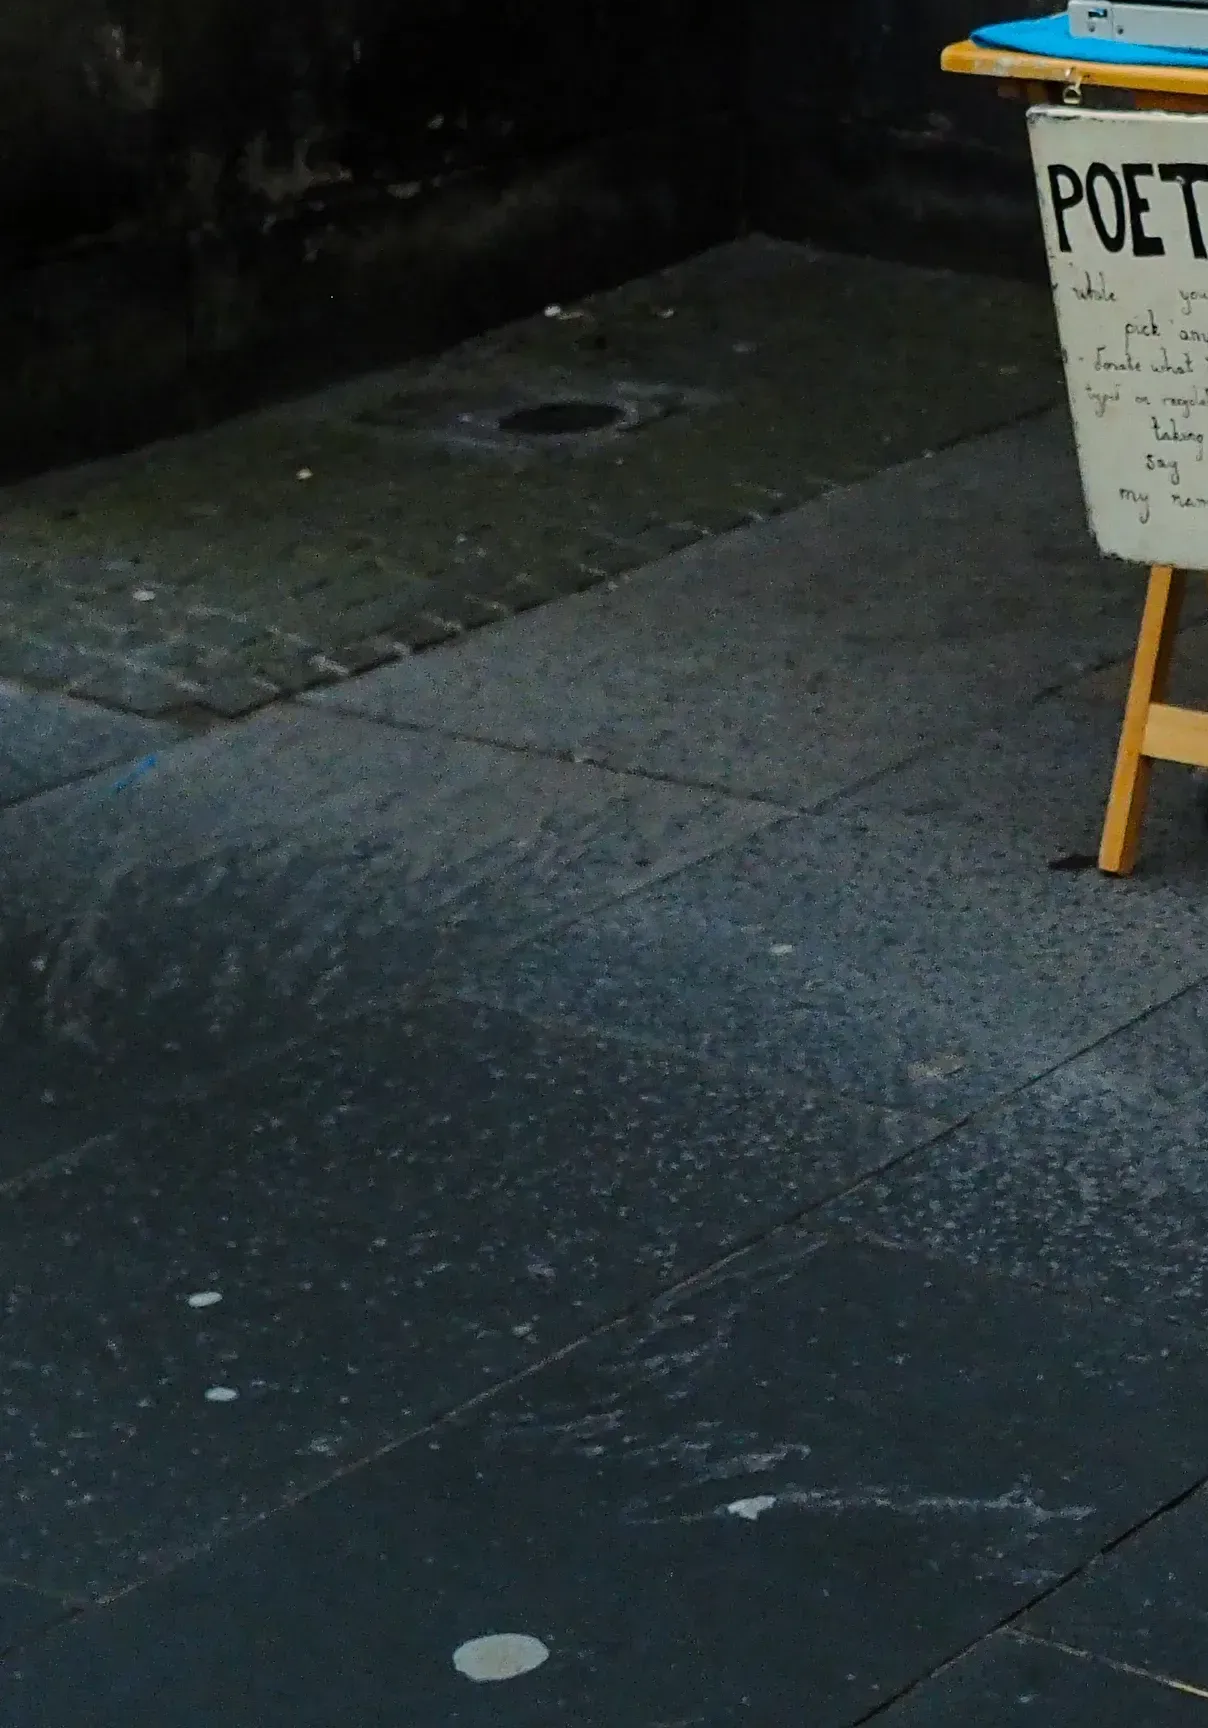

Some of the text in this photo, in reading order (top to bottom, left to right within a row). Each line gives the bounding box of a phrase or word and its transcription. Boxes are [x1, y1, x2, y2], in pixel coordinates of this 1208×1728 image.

[1179, 287, 1208, 315] you
[1125, 310, 1160, 355] pick
[1094, 347, 1141, 372] donate
[1151, 347, 1193, 374] what
[1135, 395, 1151, 406] on
[1151, 416, 1205, 461] taking
[1146, 454, 1178, 485] say
[1119, 487, 1149, 524] my
